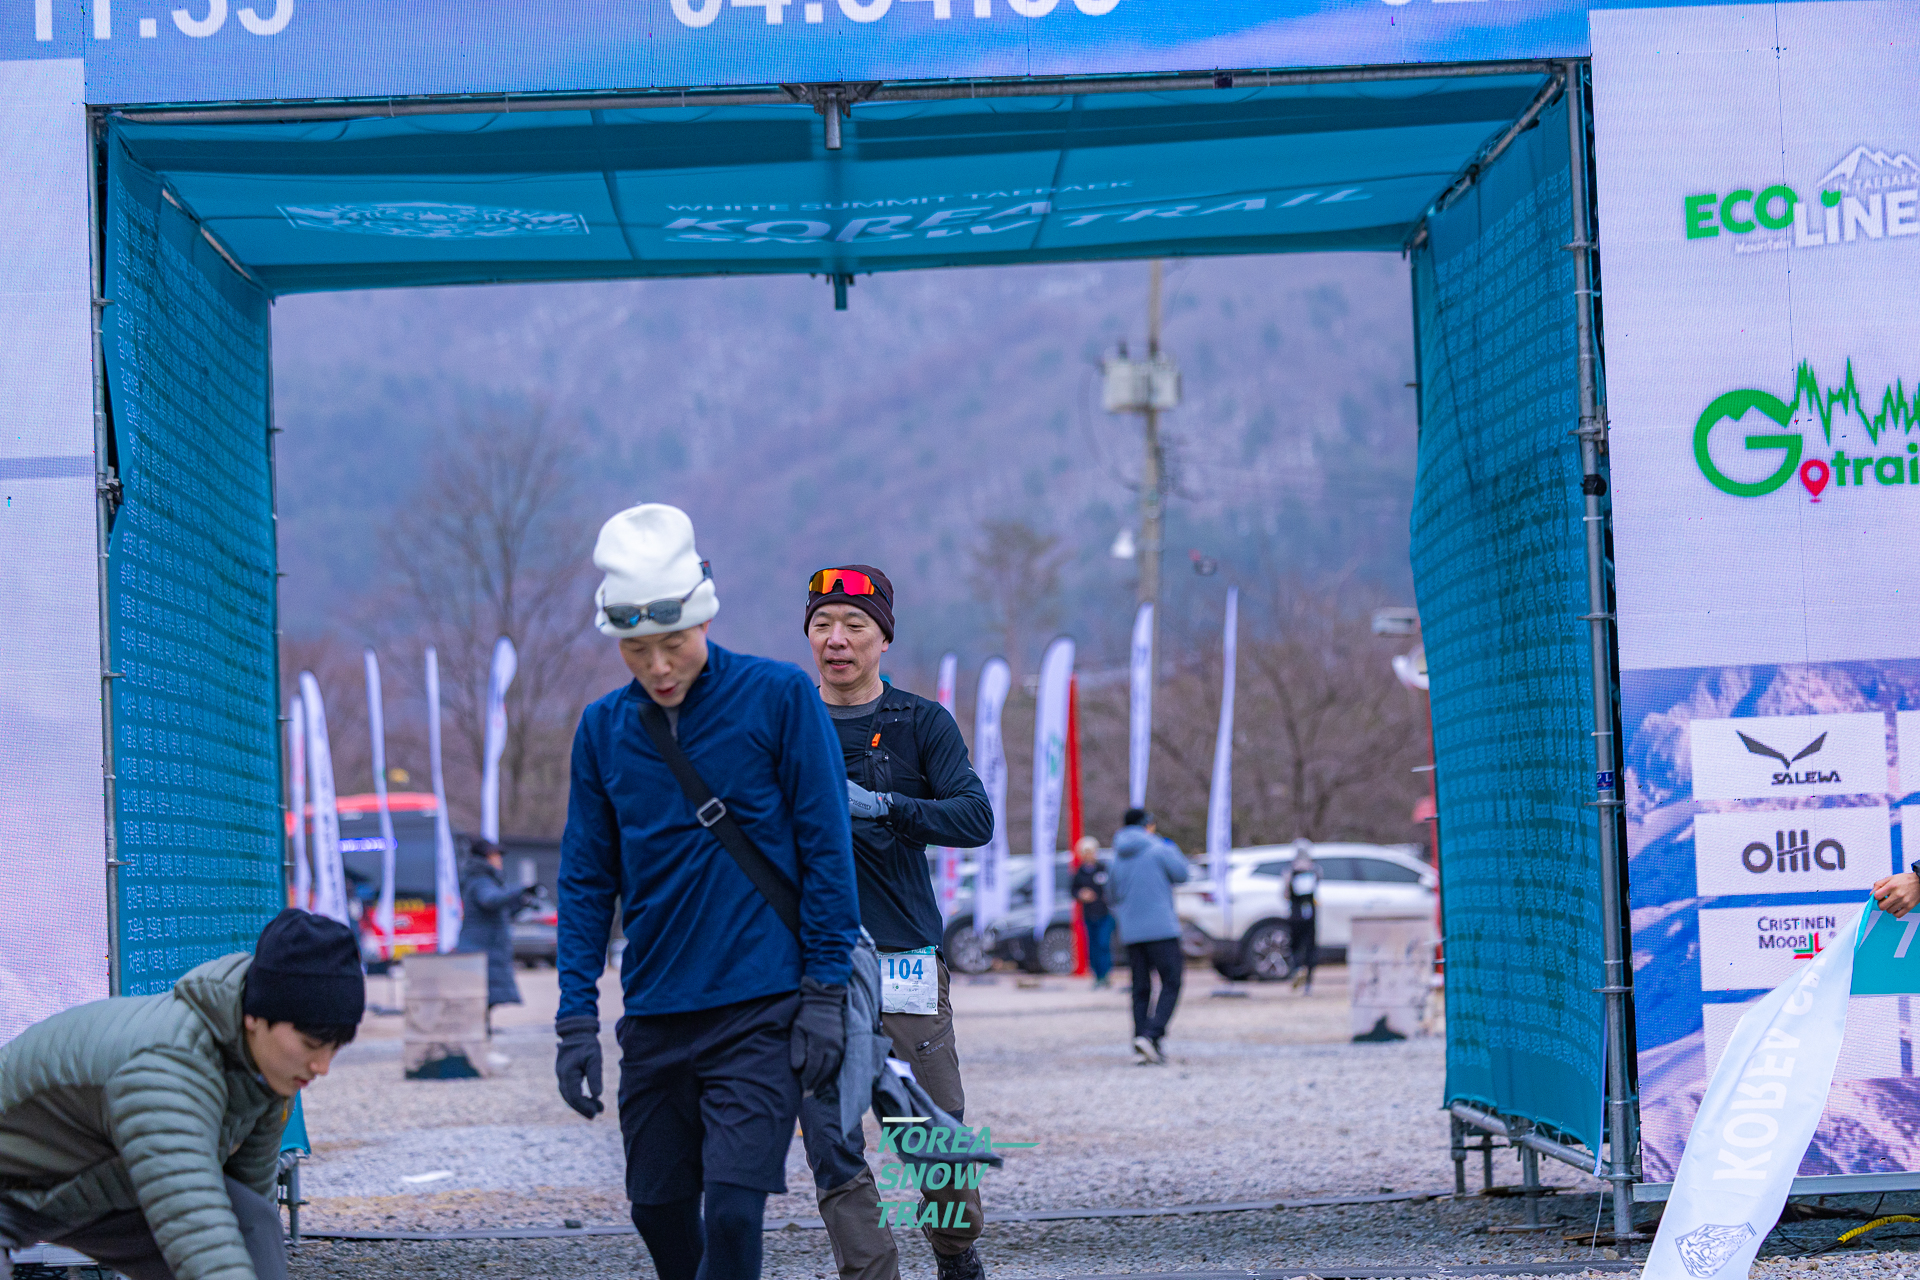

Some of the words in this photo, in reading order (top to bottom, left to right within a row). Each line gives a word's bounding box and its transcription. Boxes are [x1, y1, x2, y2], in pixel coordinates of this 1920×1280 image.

[1061, 186, 1374, 228] TRAIL
[1772, 770, 1842, 786] SALEWA
[878, 958, 924, 980] 104
